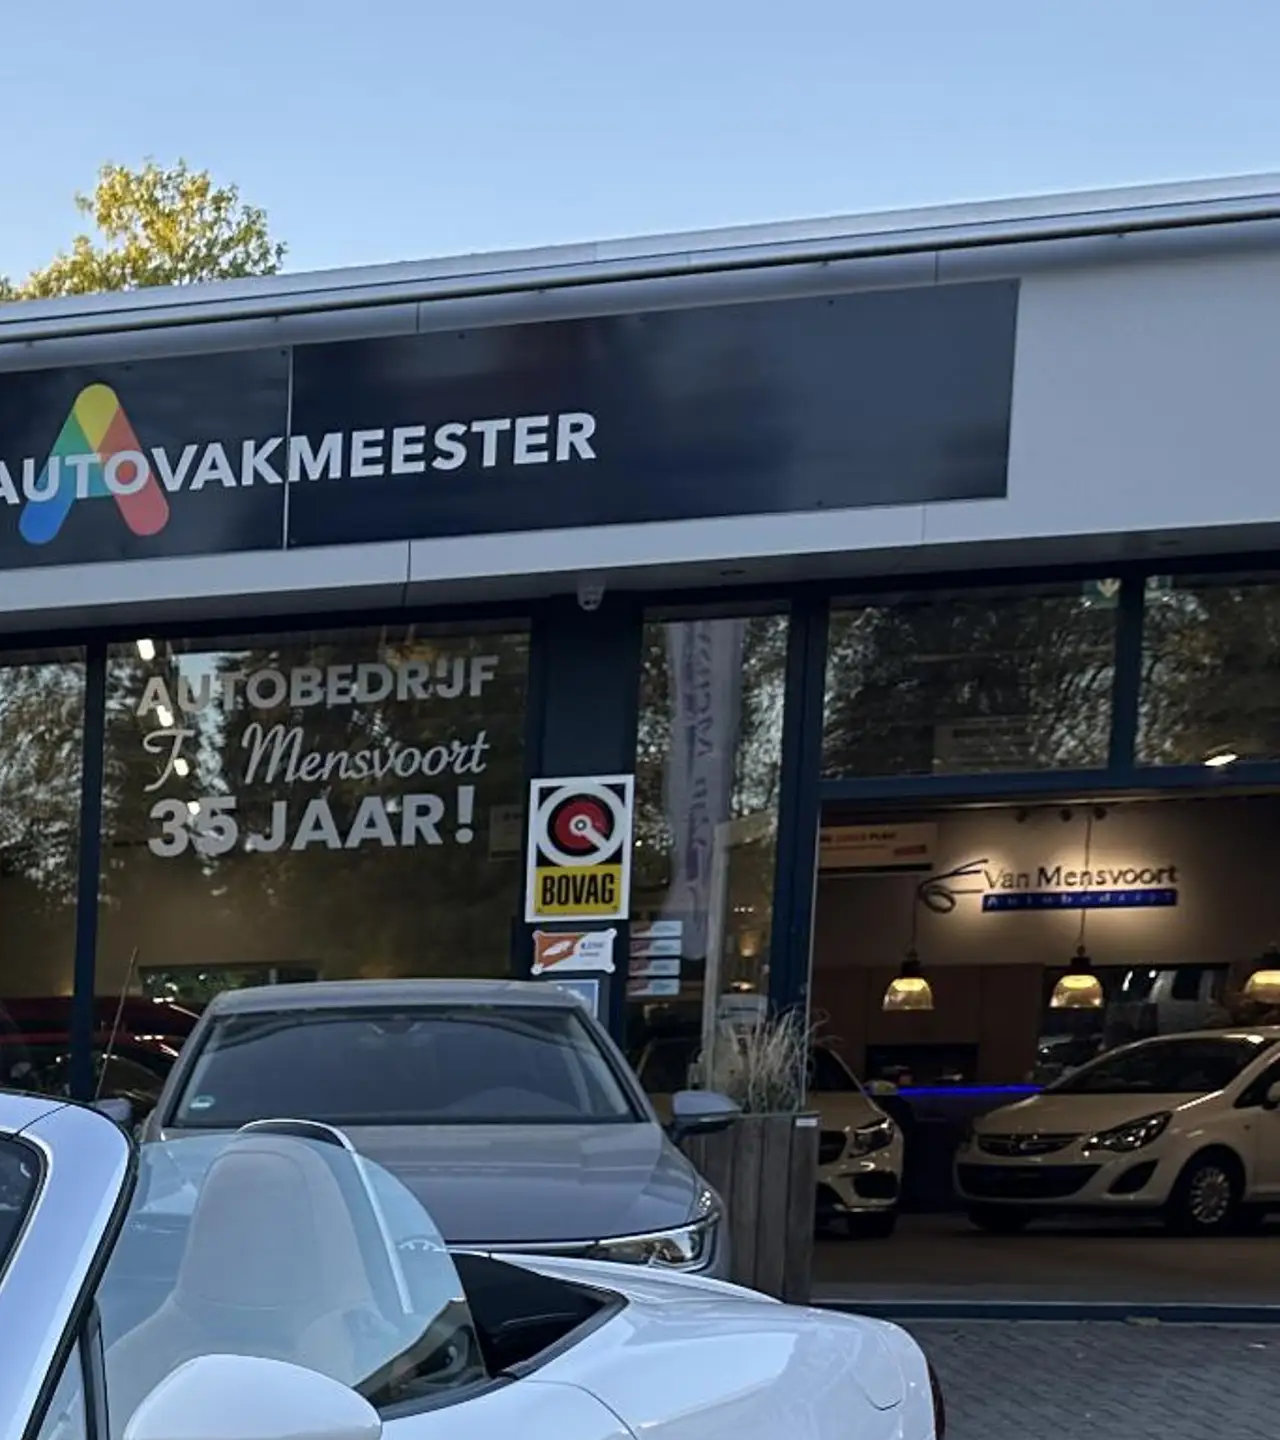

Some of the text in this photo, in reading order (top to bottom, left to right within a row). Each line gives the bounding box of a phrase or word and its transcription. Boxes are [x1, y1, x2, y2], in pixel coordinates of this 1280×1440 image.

[136, 655, 498, 717] AUTOBEDRIJF
[241, 721, 490, 785] Mensvoort
[148, 785, 476, 858] 35 JAAR!
[542, 872, 615, 906] BOVAG
[984, 864, 1180, 890] Van Mensvoort
